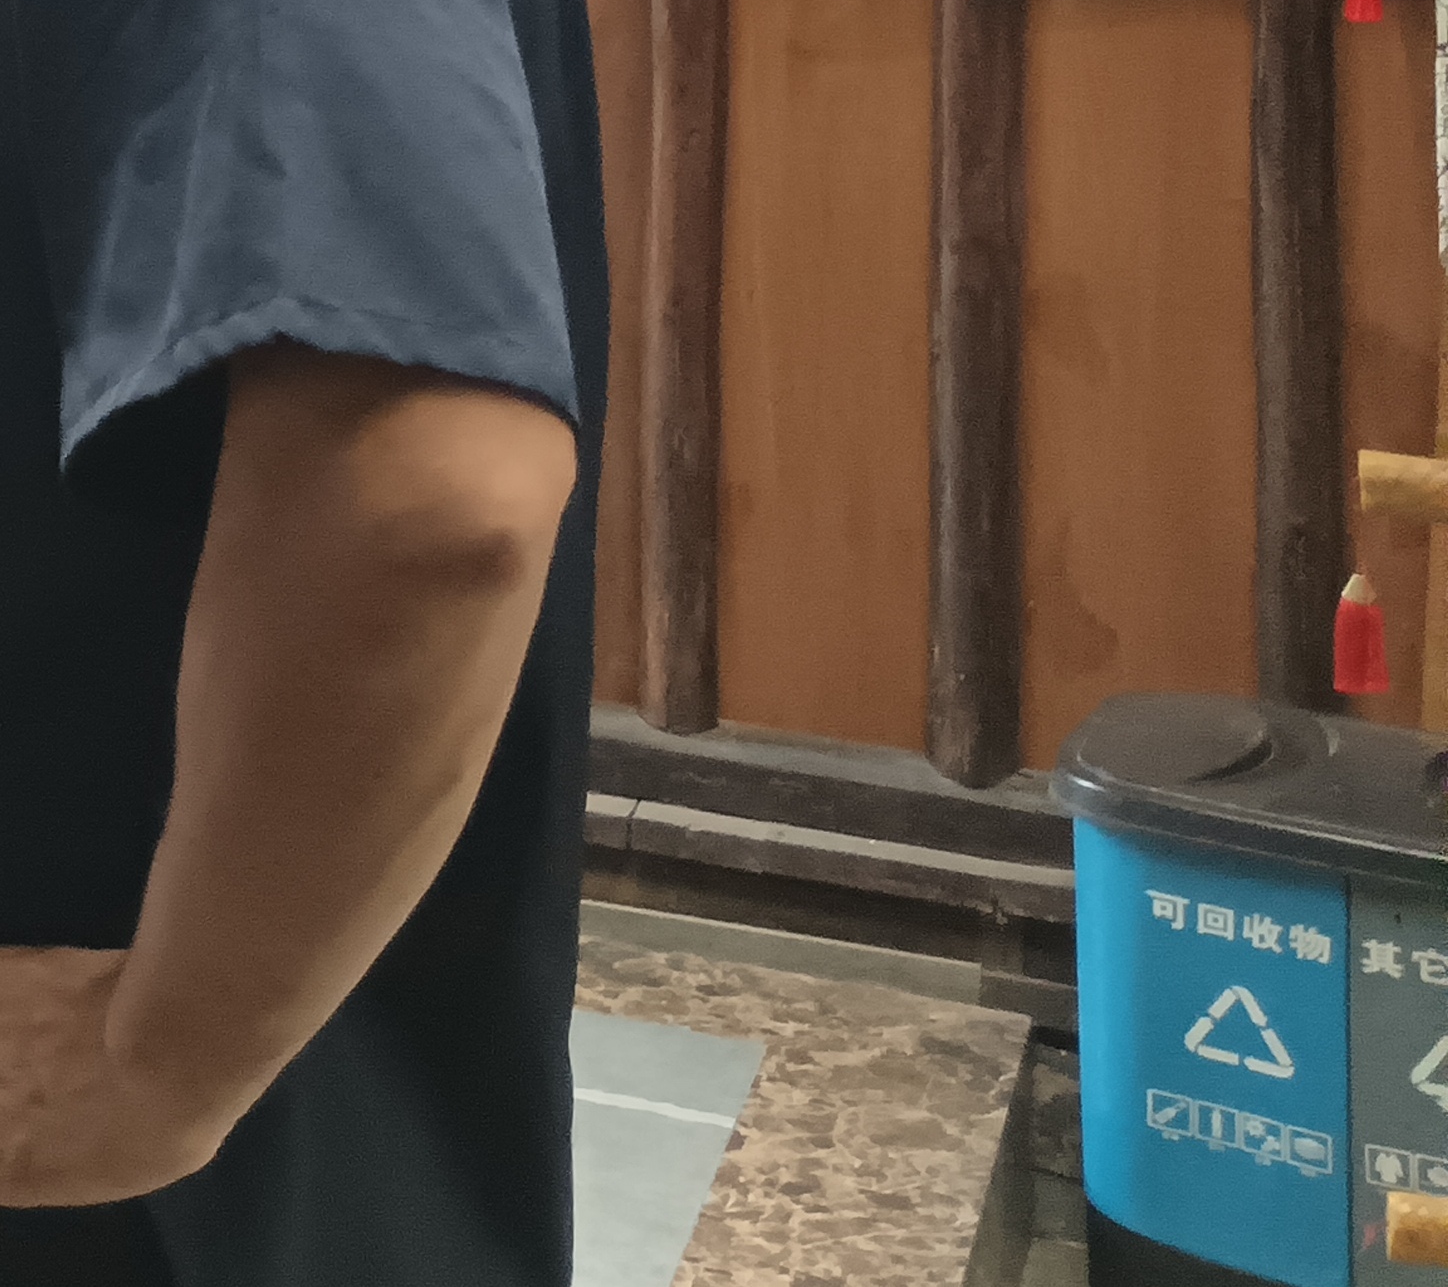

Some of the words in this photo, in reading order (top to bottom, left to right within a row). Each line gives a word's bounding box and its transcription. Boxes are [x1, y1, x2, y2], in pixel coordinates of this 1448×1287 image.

[1145, 889, 1333, 964] 可回收物
[1360, 937, 1448, 986] 其它
